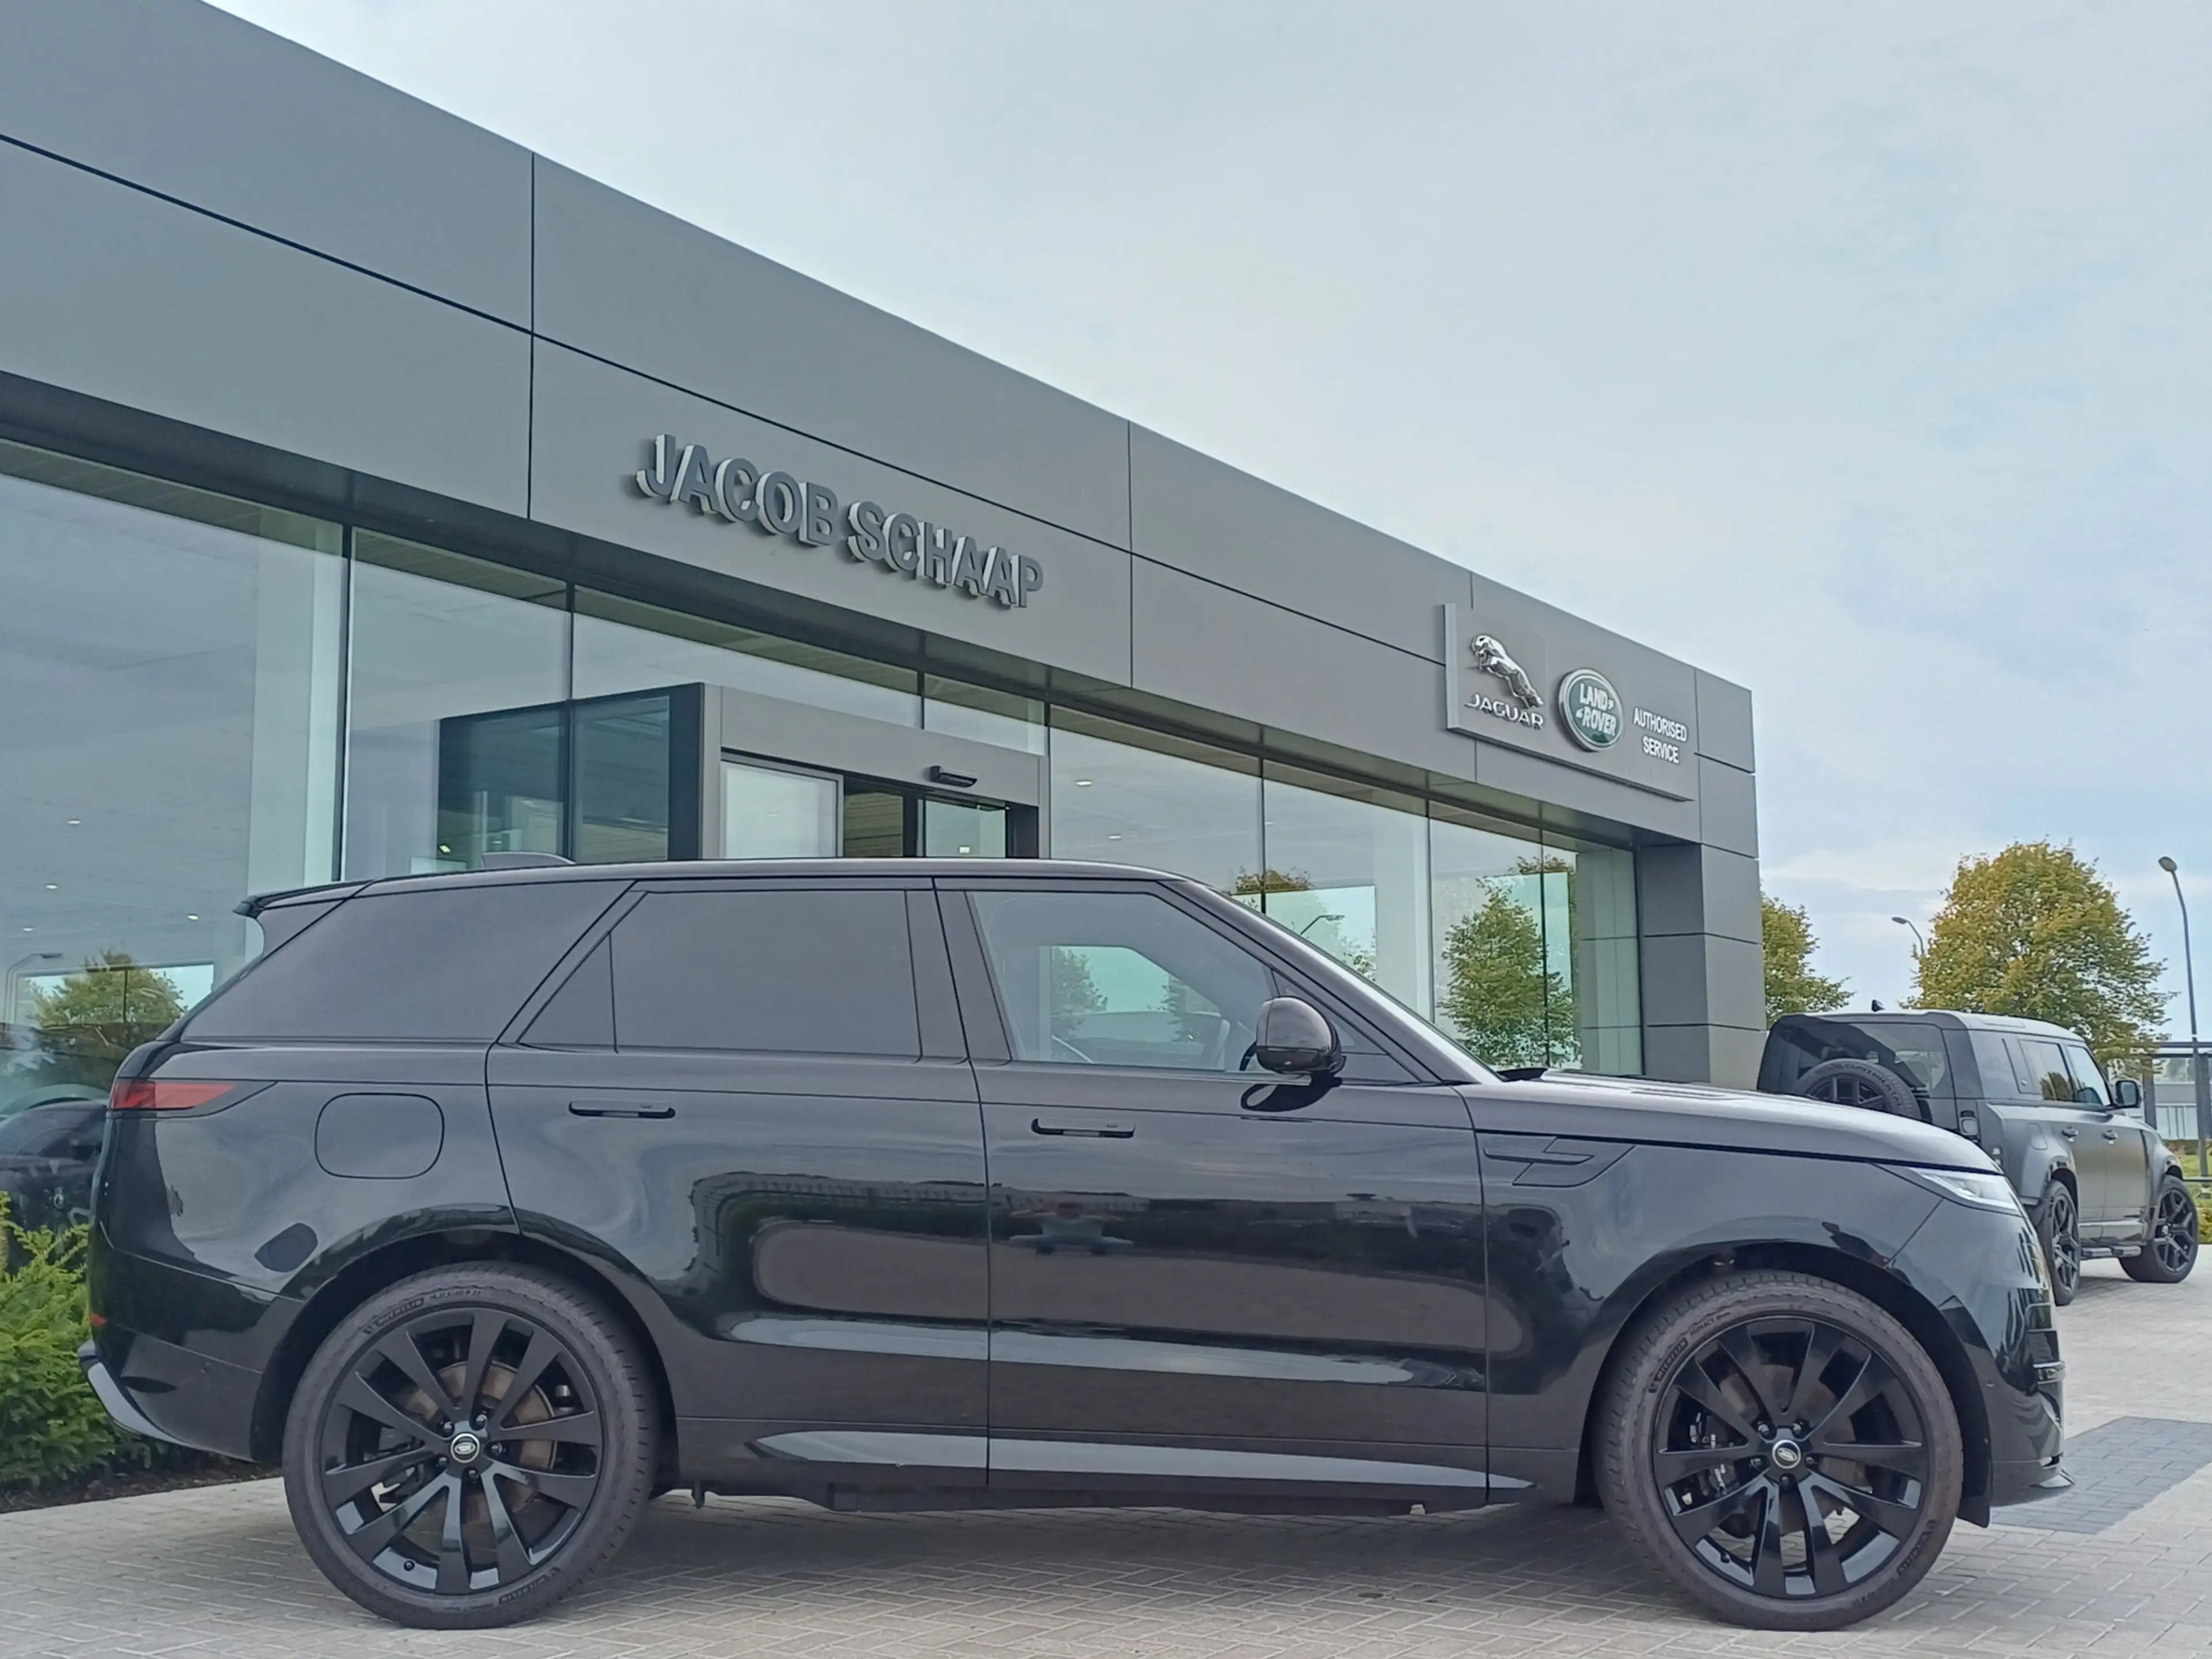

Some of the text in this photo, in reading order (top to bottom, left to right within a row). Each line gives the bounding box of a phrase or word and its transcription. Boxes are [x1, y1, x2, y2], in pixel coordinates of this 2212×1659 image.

[637, 434, 1043, 608] JACOB SCHAAP
[1466, 694, 1544, 729] JAGUAR
[1580, 683, 1608, 711] LAND
[1582, 706, 1616, 736] ROVER
[1633, 707, 1687, 742] AUTHORISED
[1642, 736, 1680, 764] SERVICE
